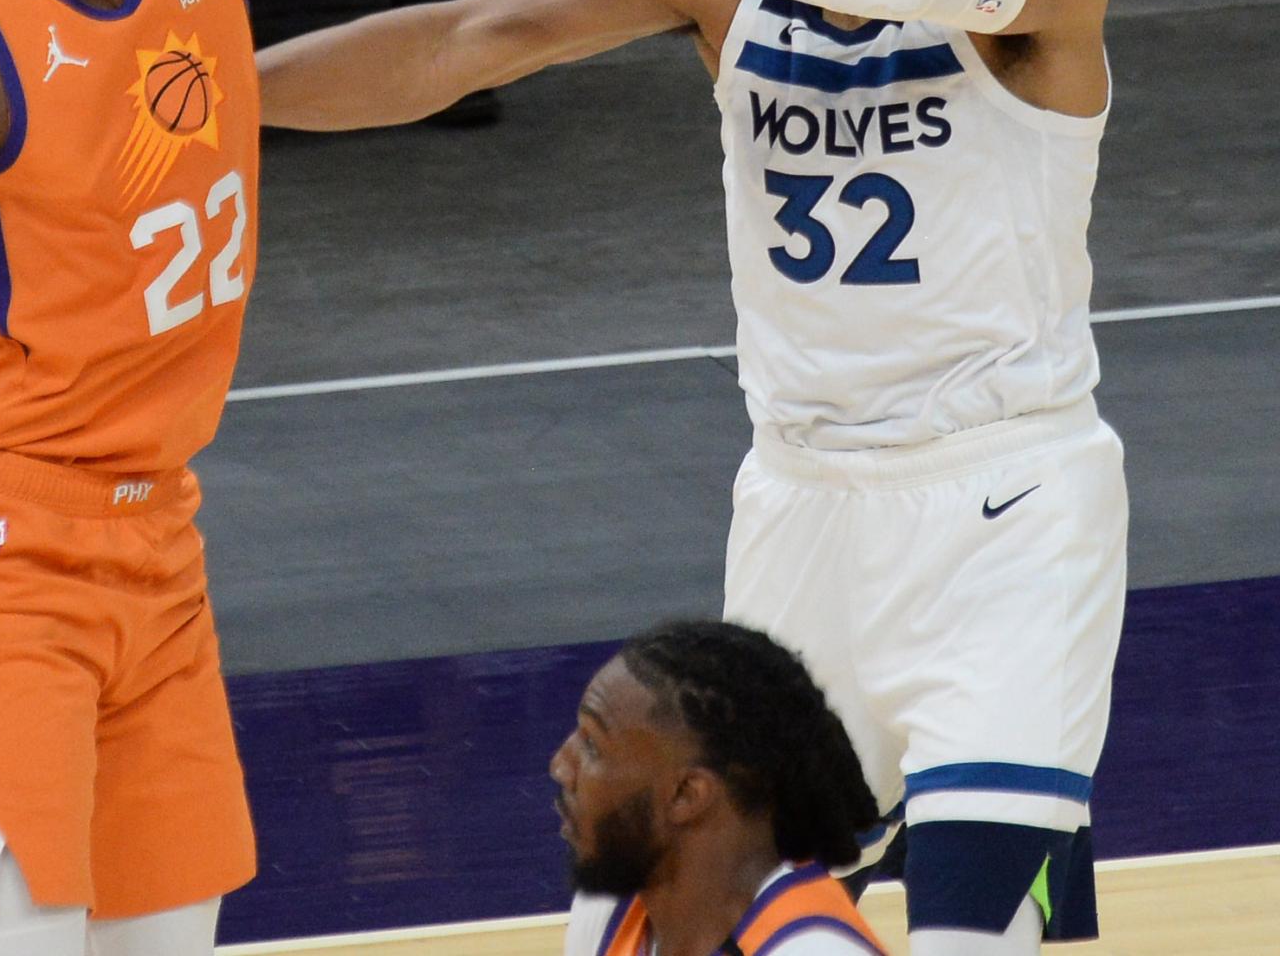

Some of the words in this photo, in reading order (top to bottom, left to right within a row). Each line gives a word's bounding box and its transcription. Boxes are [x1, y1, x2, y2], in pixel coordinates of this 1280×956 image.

[749, 90, 952, 157] WOLVES
[129, 171, 246, 336] 22
[764, 168, 920, 285] 32
[112, 482, 154, 505] PHX
